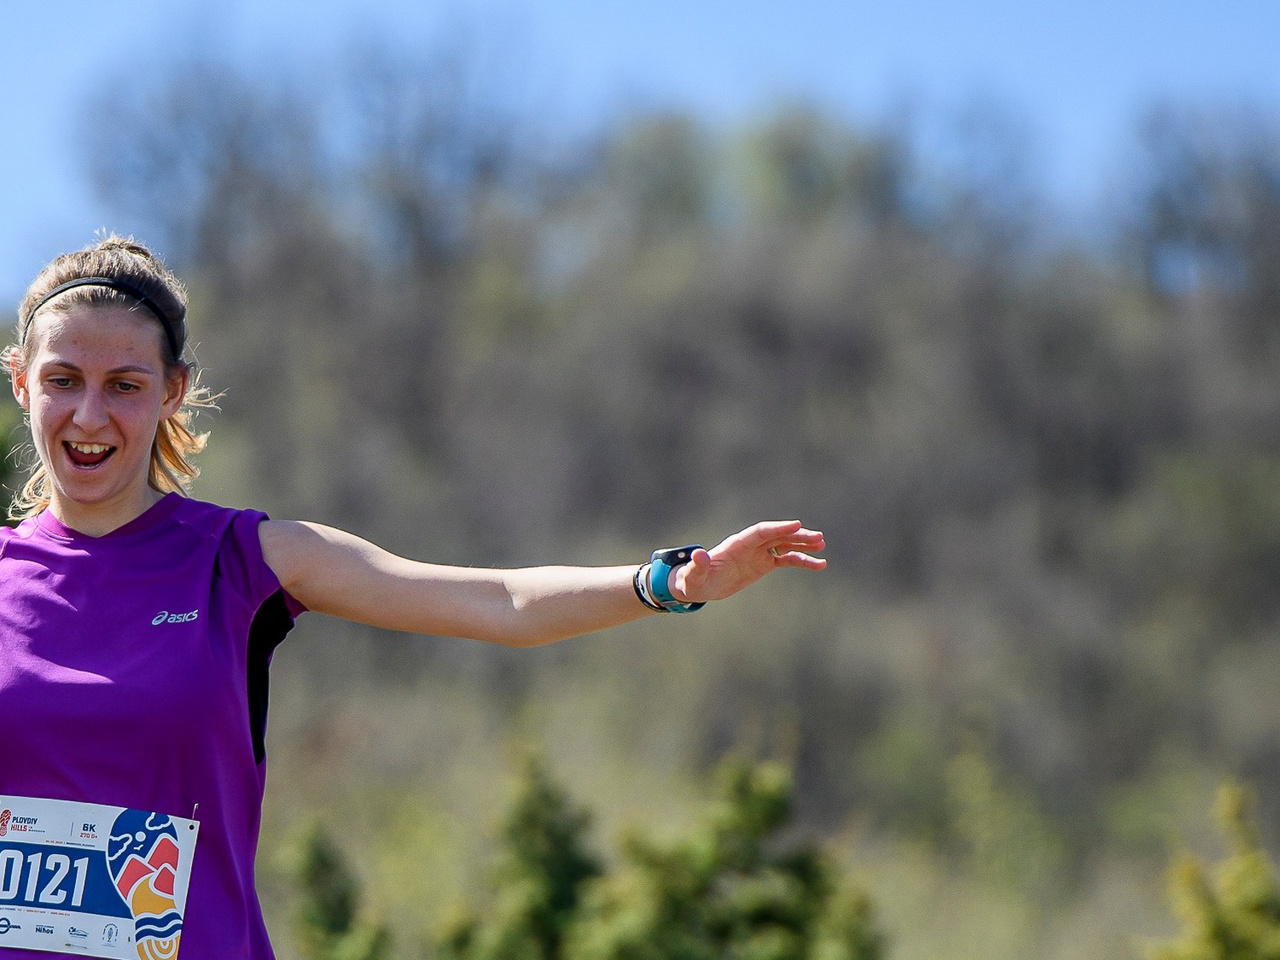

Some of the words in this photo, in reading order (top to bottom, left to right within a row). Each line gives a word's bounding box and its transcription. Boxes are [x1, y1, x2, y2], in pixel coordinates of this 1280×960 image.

[167, 609, 199, 624] asics
[11, 816, 38, 825] PLOVDIV
[10, 824, 28, 832] HILLS
[82, 823, 97, 833] 6K
